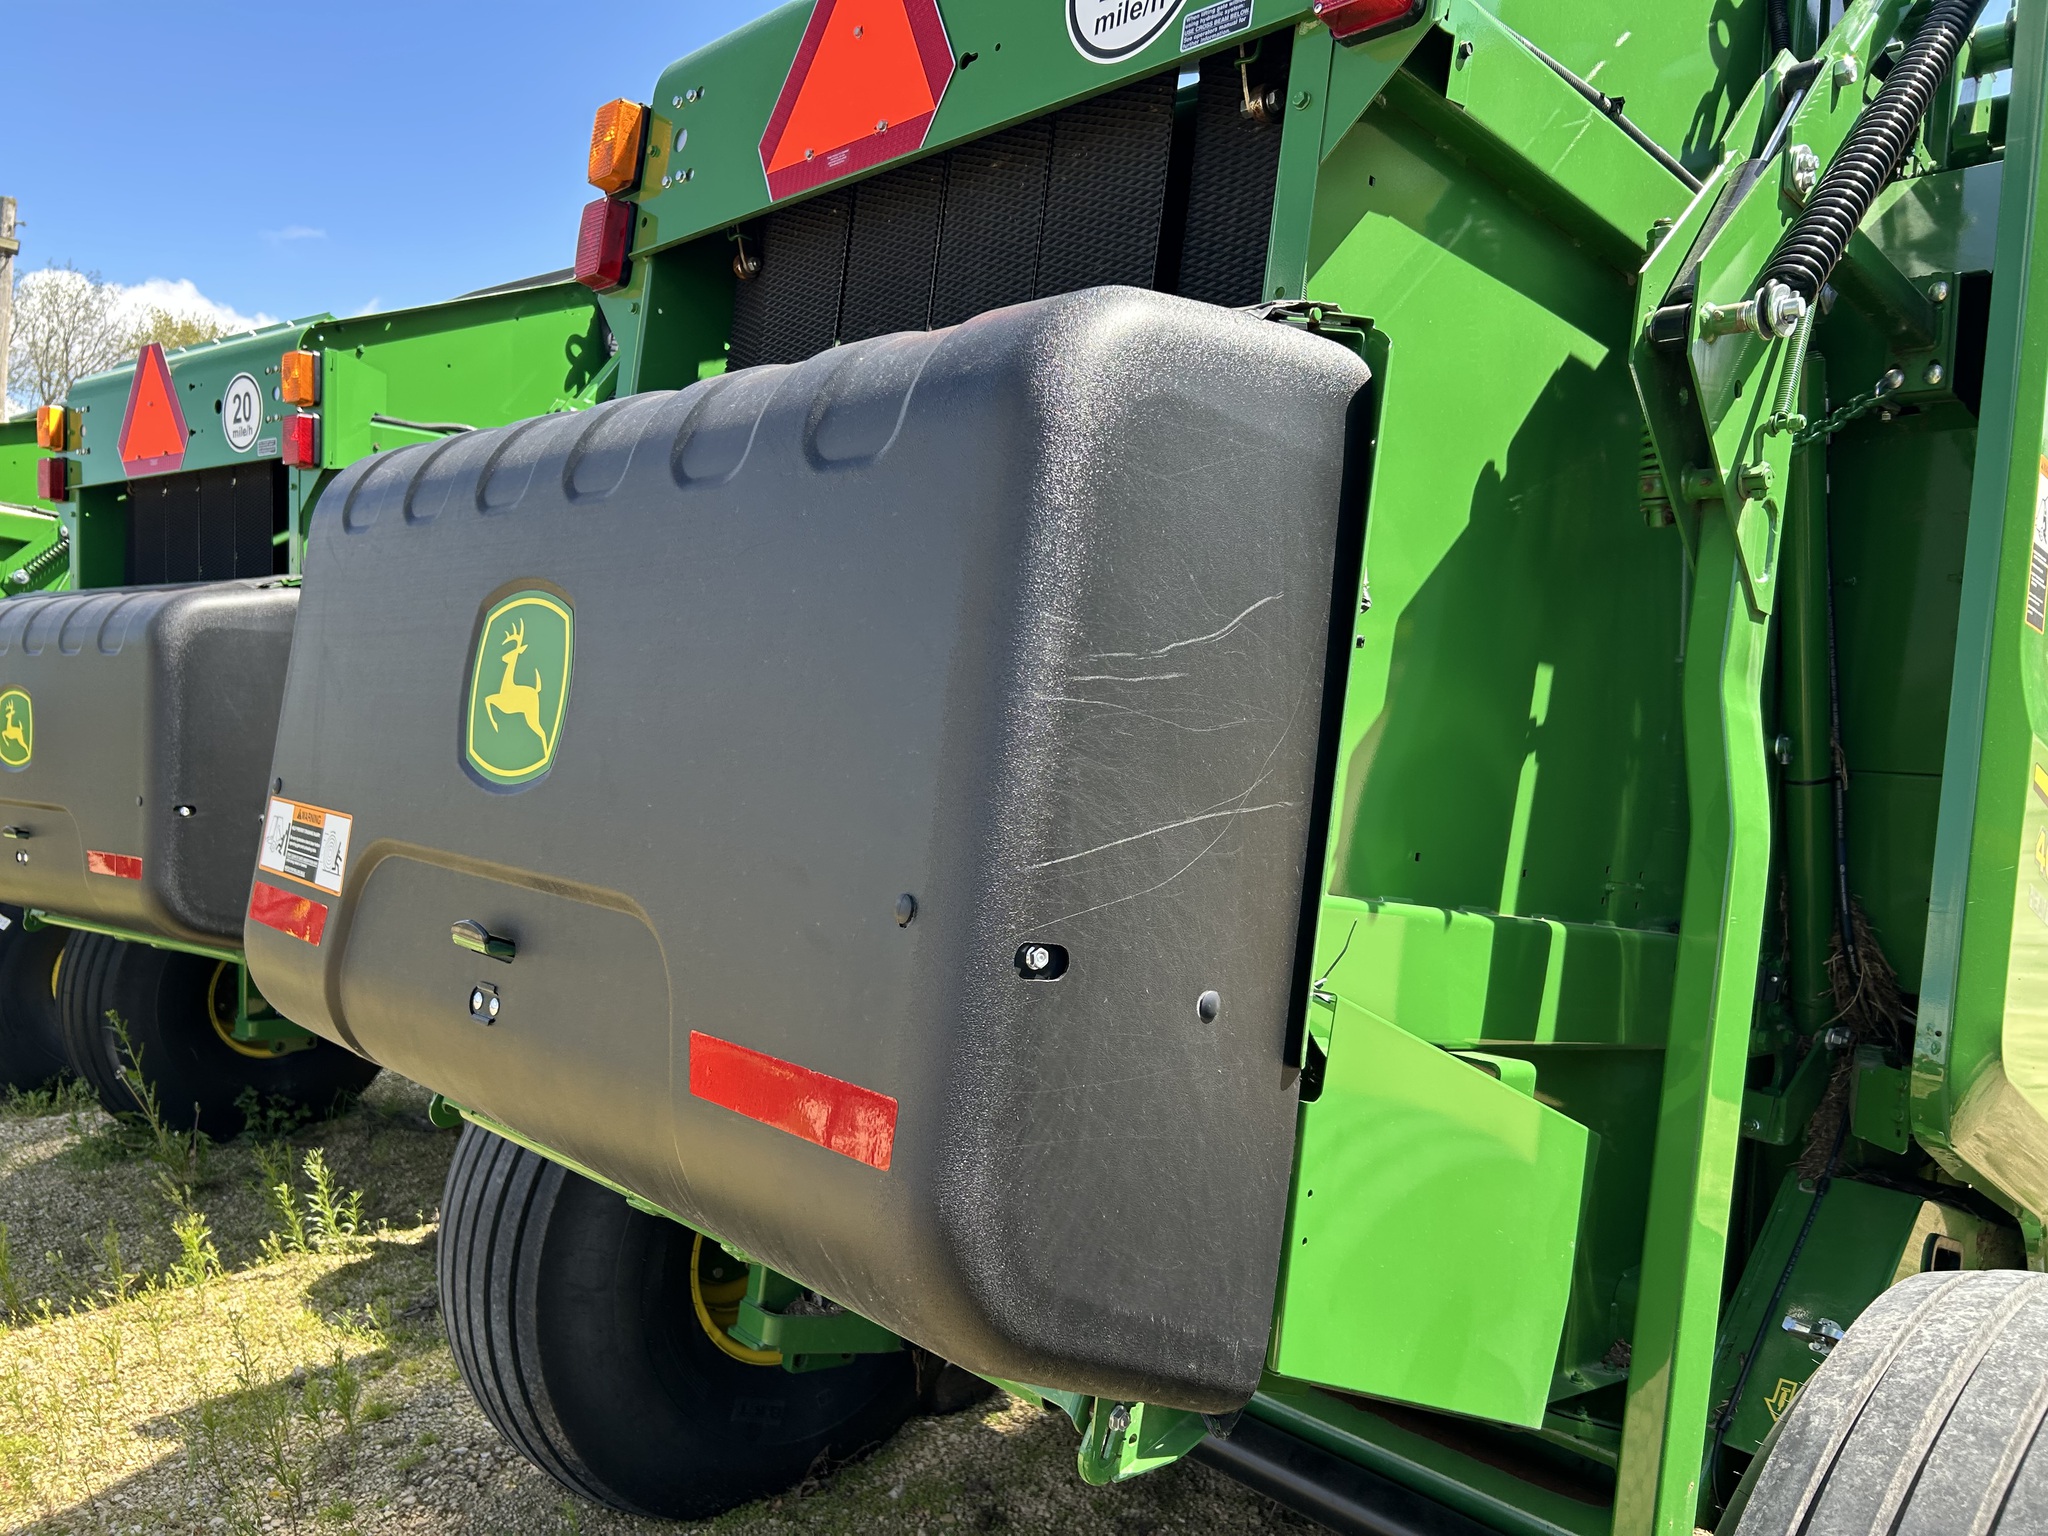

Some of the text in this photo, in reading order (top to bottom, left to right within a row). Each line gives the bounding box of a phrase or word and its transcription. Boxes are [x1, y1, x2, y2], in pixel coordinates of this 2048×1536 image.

[1184, 7, 1250, 37] USE CROSS BEAM BELOW
[1200, 11, 1224, 24] hydraulic
[1183, 36, 1193, 44] See
[1218, 18, 1238, 31] manual
[1239, 16, 1247, 24] for
[233, 391, 252, 425] 20
[233, 424, 253, 439] mile/h
[301, 811, 322, 825] WARNING
